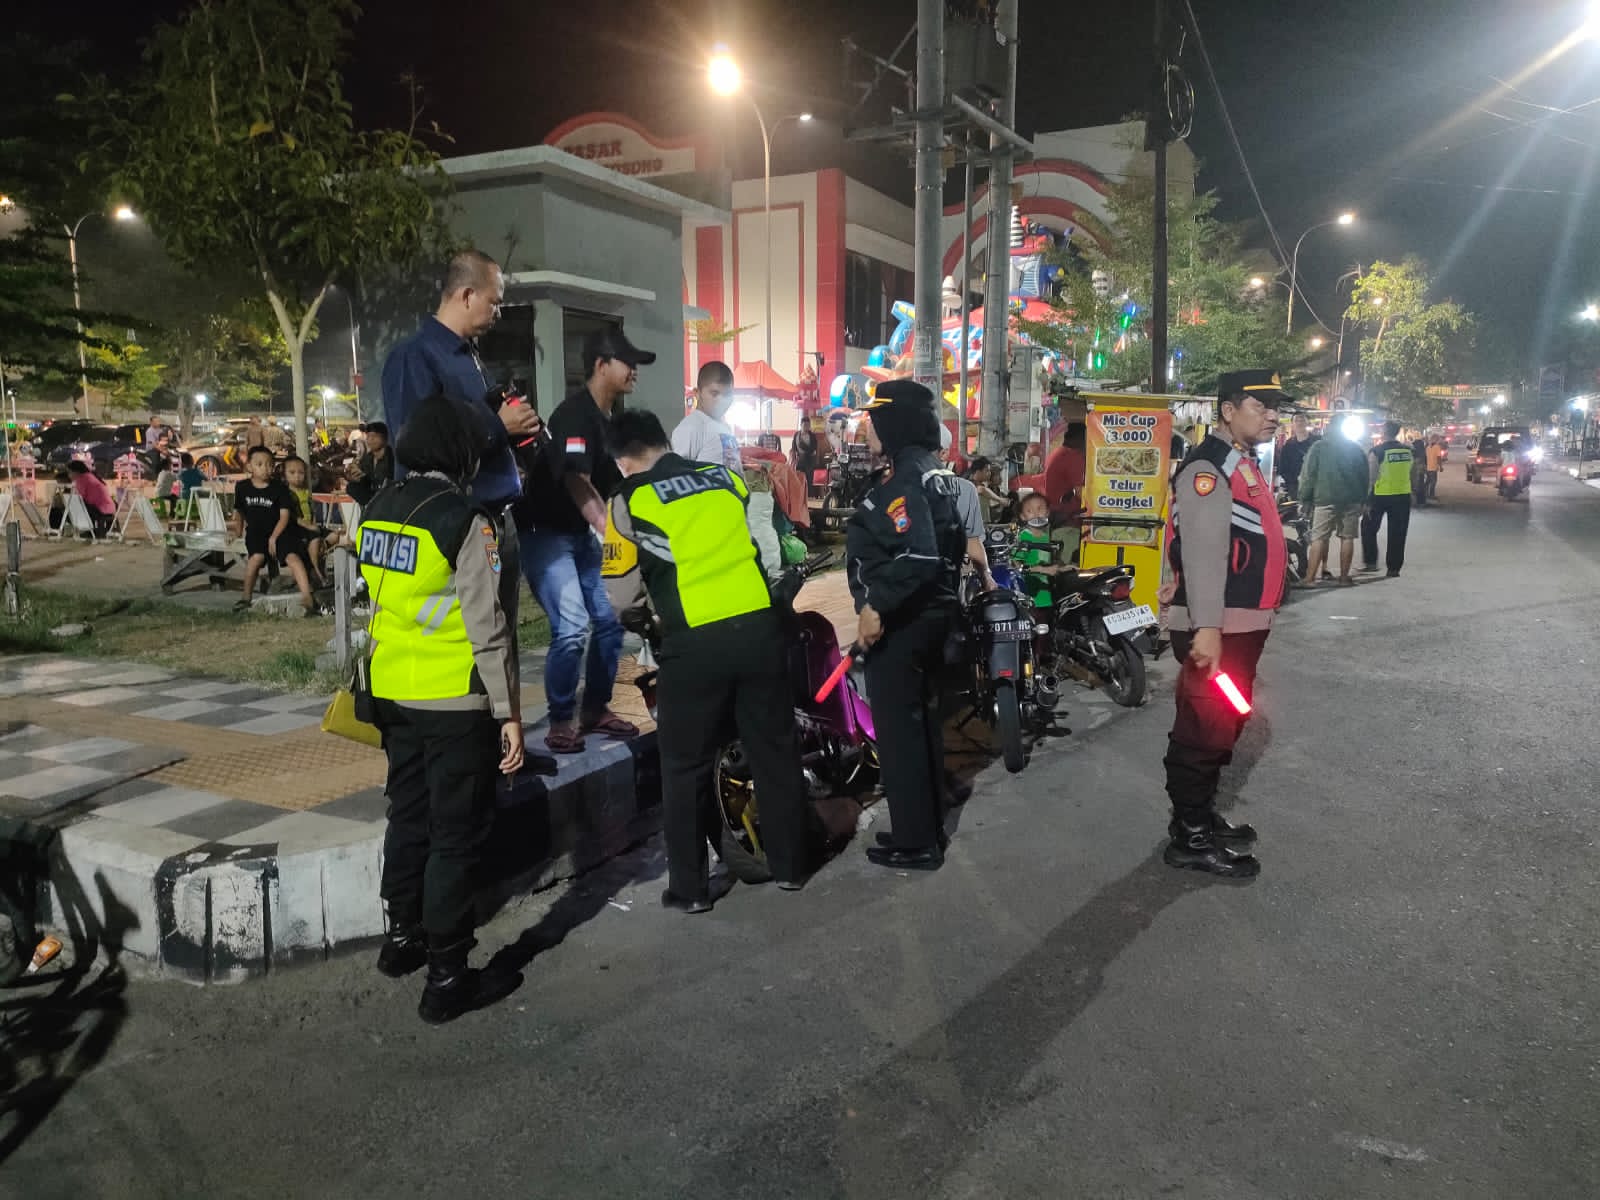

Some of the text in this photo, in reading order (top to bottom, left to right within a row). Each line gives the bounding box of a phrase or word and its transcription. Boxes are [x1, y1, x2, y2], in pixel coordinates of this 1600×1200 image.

[1102, 414, 1156, 428] Mie Cup
[1105, 429, 1152, 443] (3.000)
[1109, 480, 1143, 490] Telur
[1098, 495, 1153, 509] Congkel
[360, 529, 417, 573] POLISI
